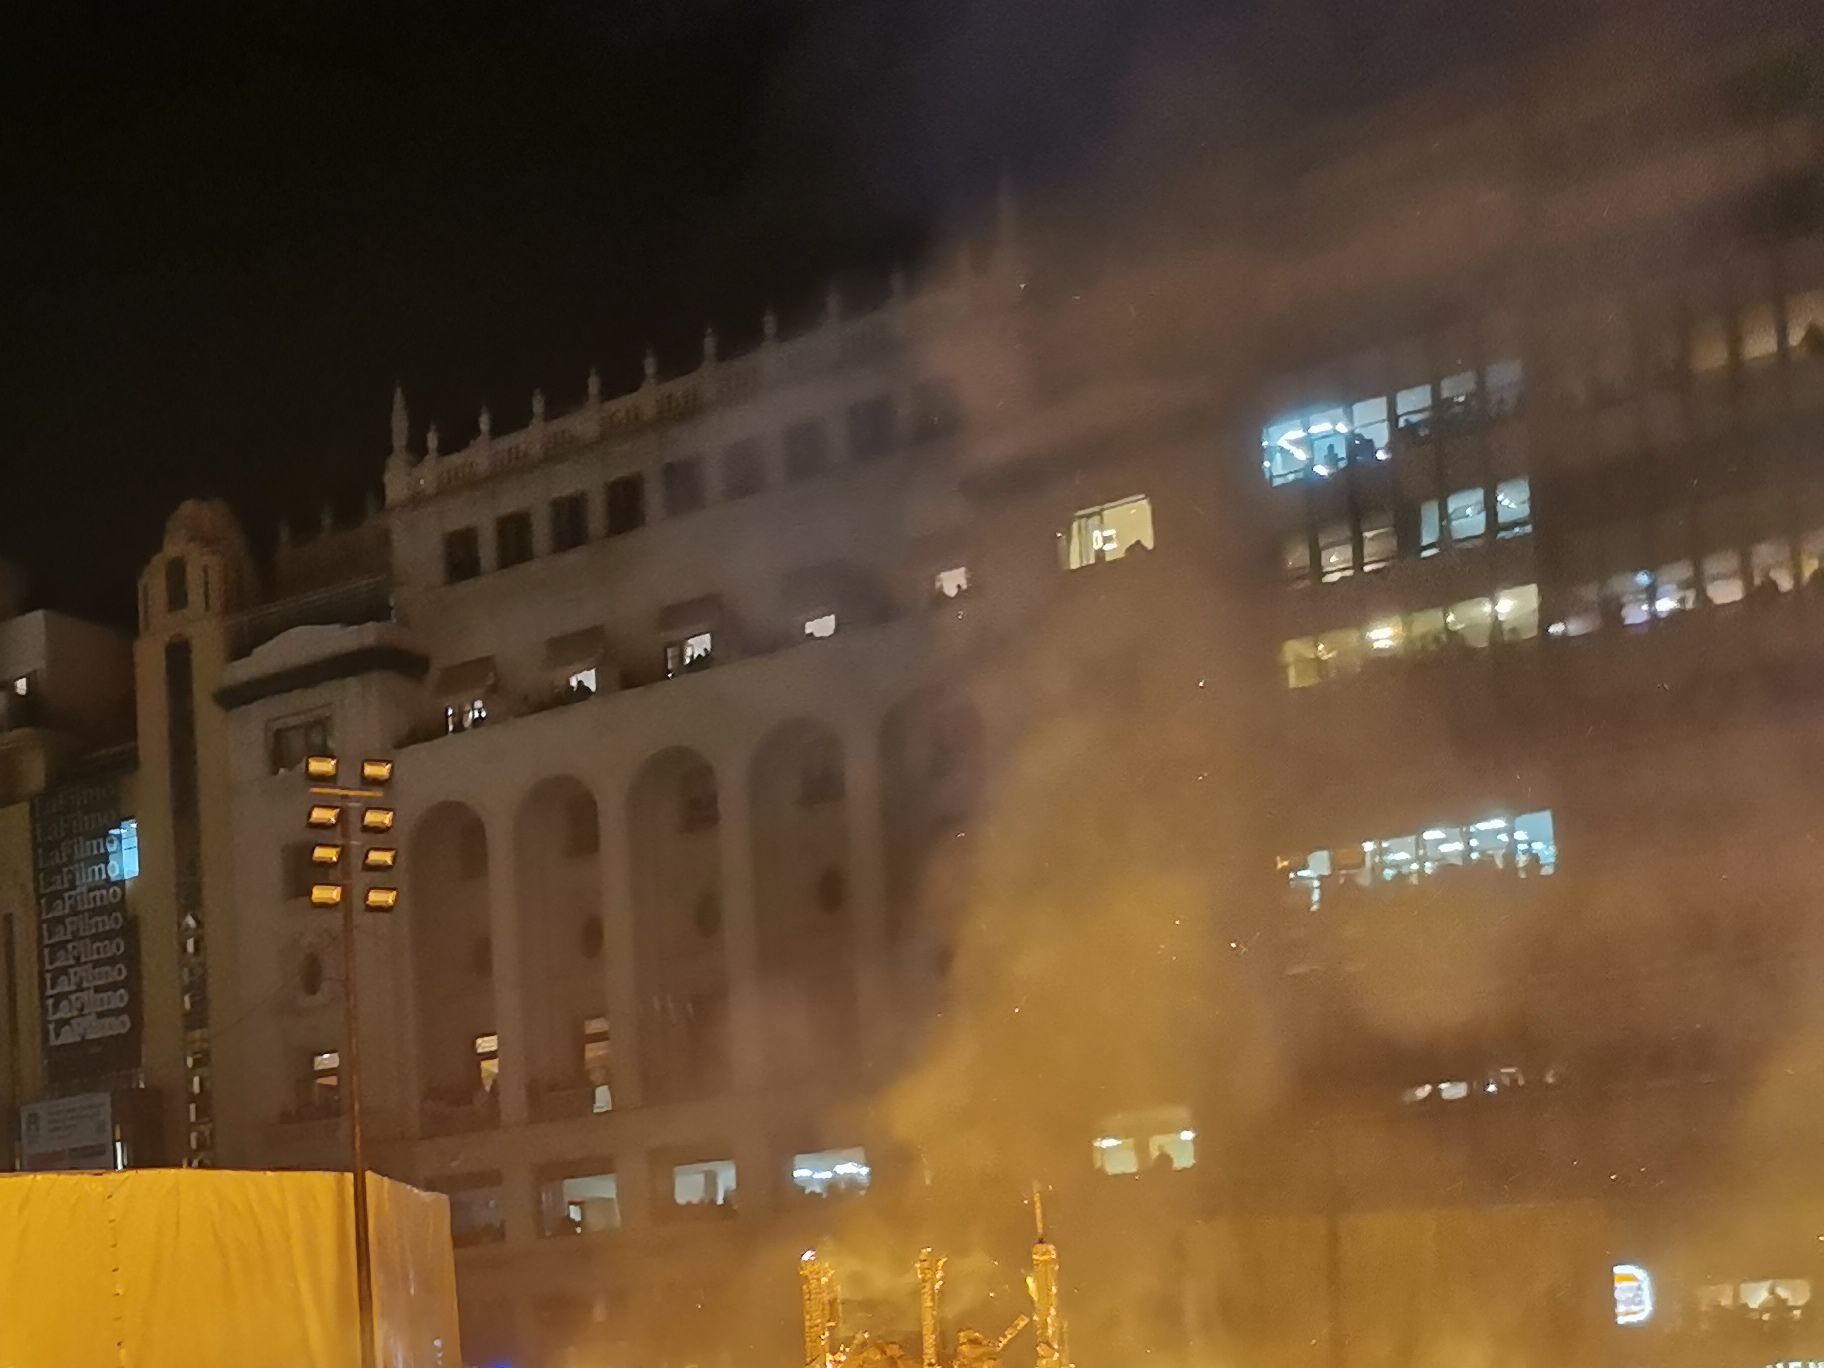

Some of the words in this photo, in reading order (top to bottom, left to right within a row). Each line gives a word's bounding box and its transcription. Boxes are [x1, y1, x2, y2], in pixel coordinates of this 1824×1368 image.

[41, 885, 122, 919] LaFilmo
[42, 911, 123, 944] LaFilmo
[44, 937, 125, 970] LaFilmo
